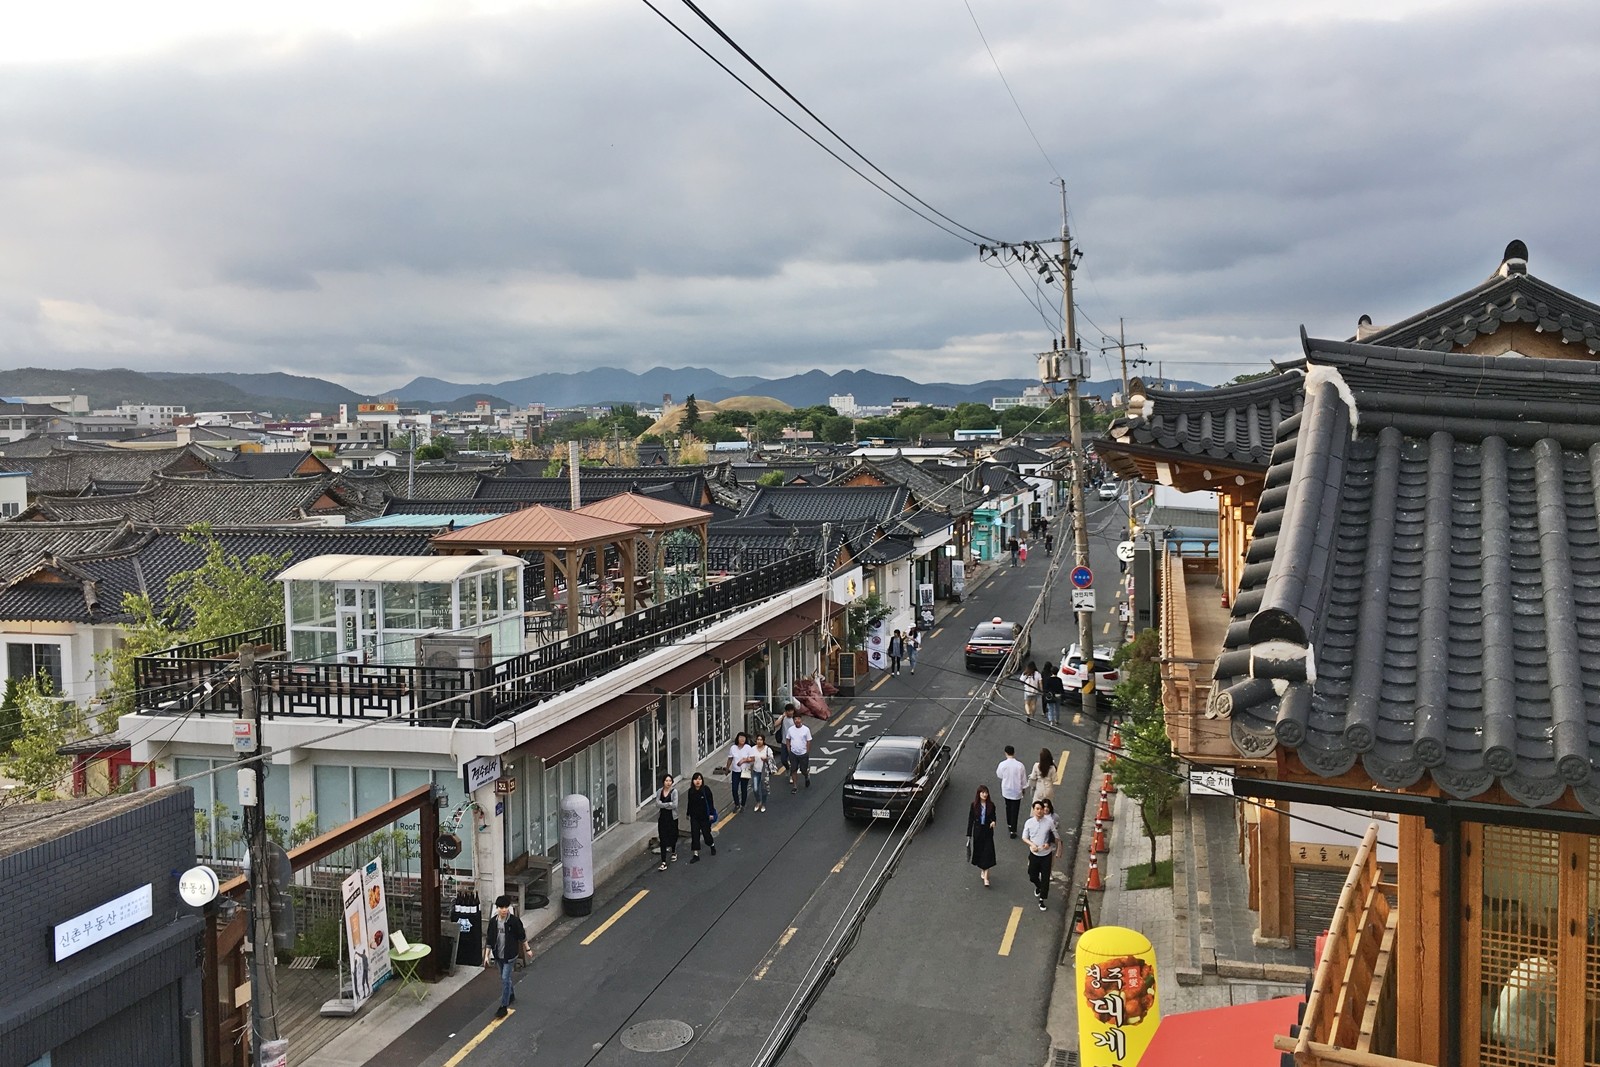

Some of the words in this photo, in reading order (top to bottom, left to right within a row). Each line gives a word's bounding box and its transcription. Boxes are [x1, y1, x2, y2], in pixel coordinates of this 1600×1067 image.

[400, 822, 416, 831] Roof
[180, 881, 207, 895] 부동산
[59, 910, 117, 949] 신촌부동산
[1084, 963, 1123, 989] 경주
